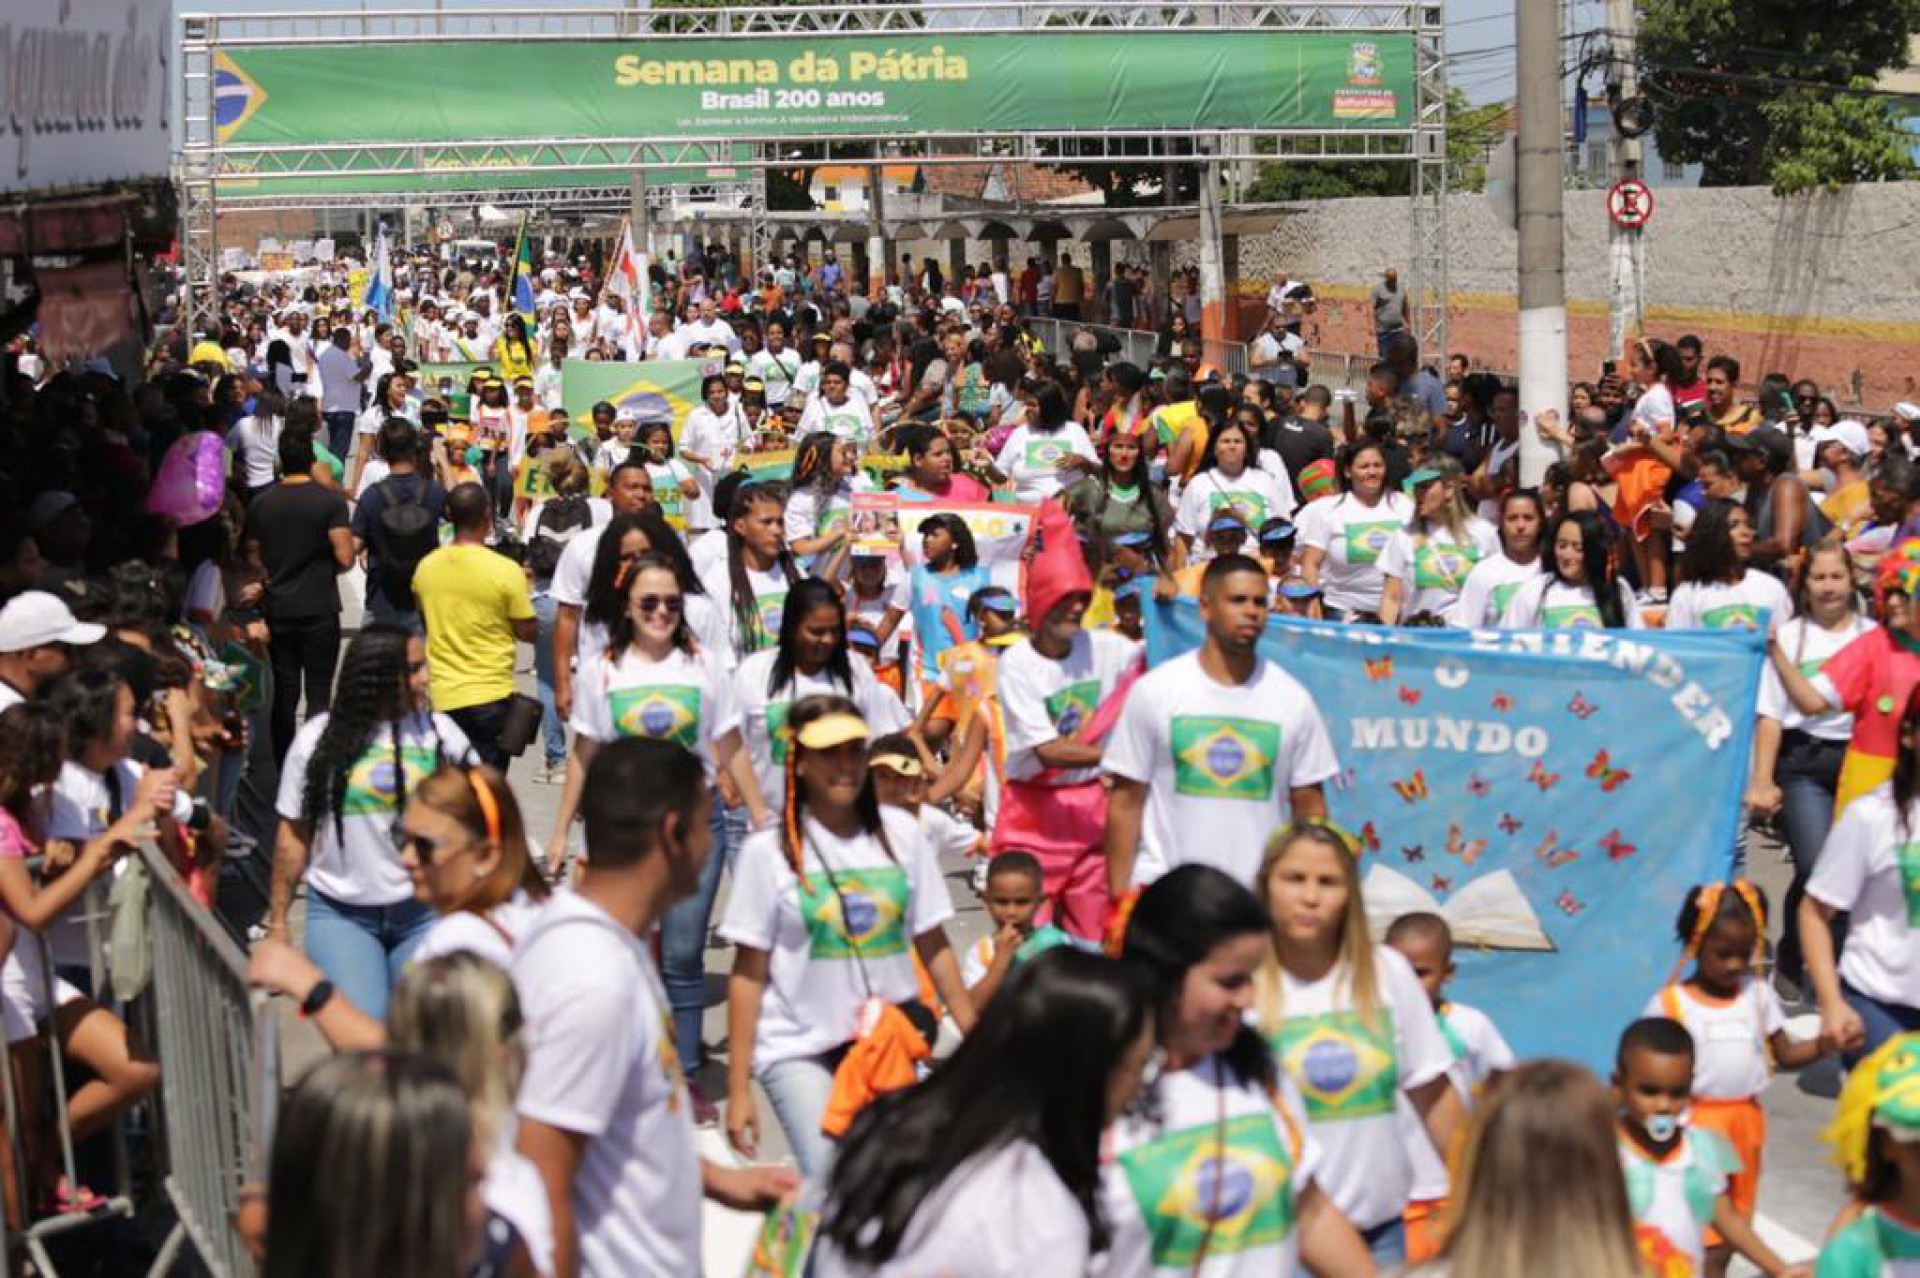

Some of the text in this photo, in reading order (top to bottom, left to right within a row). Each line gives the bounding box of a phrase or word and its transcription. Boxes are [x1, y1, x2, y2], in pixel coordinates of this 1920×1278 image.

[614, 44, 968, 86] Semana da Pátria
[702, 87, 886, 110] Brasil 200 anos
[1351, 716, 1548, 757] MUNDO
